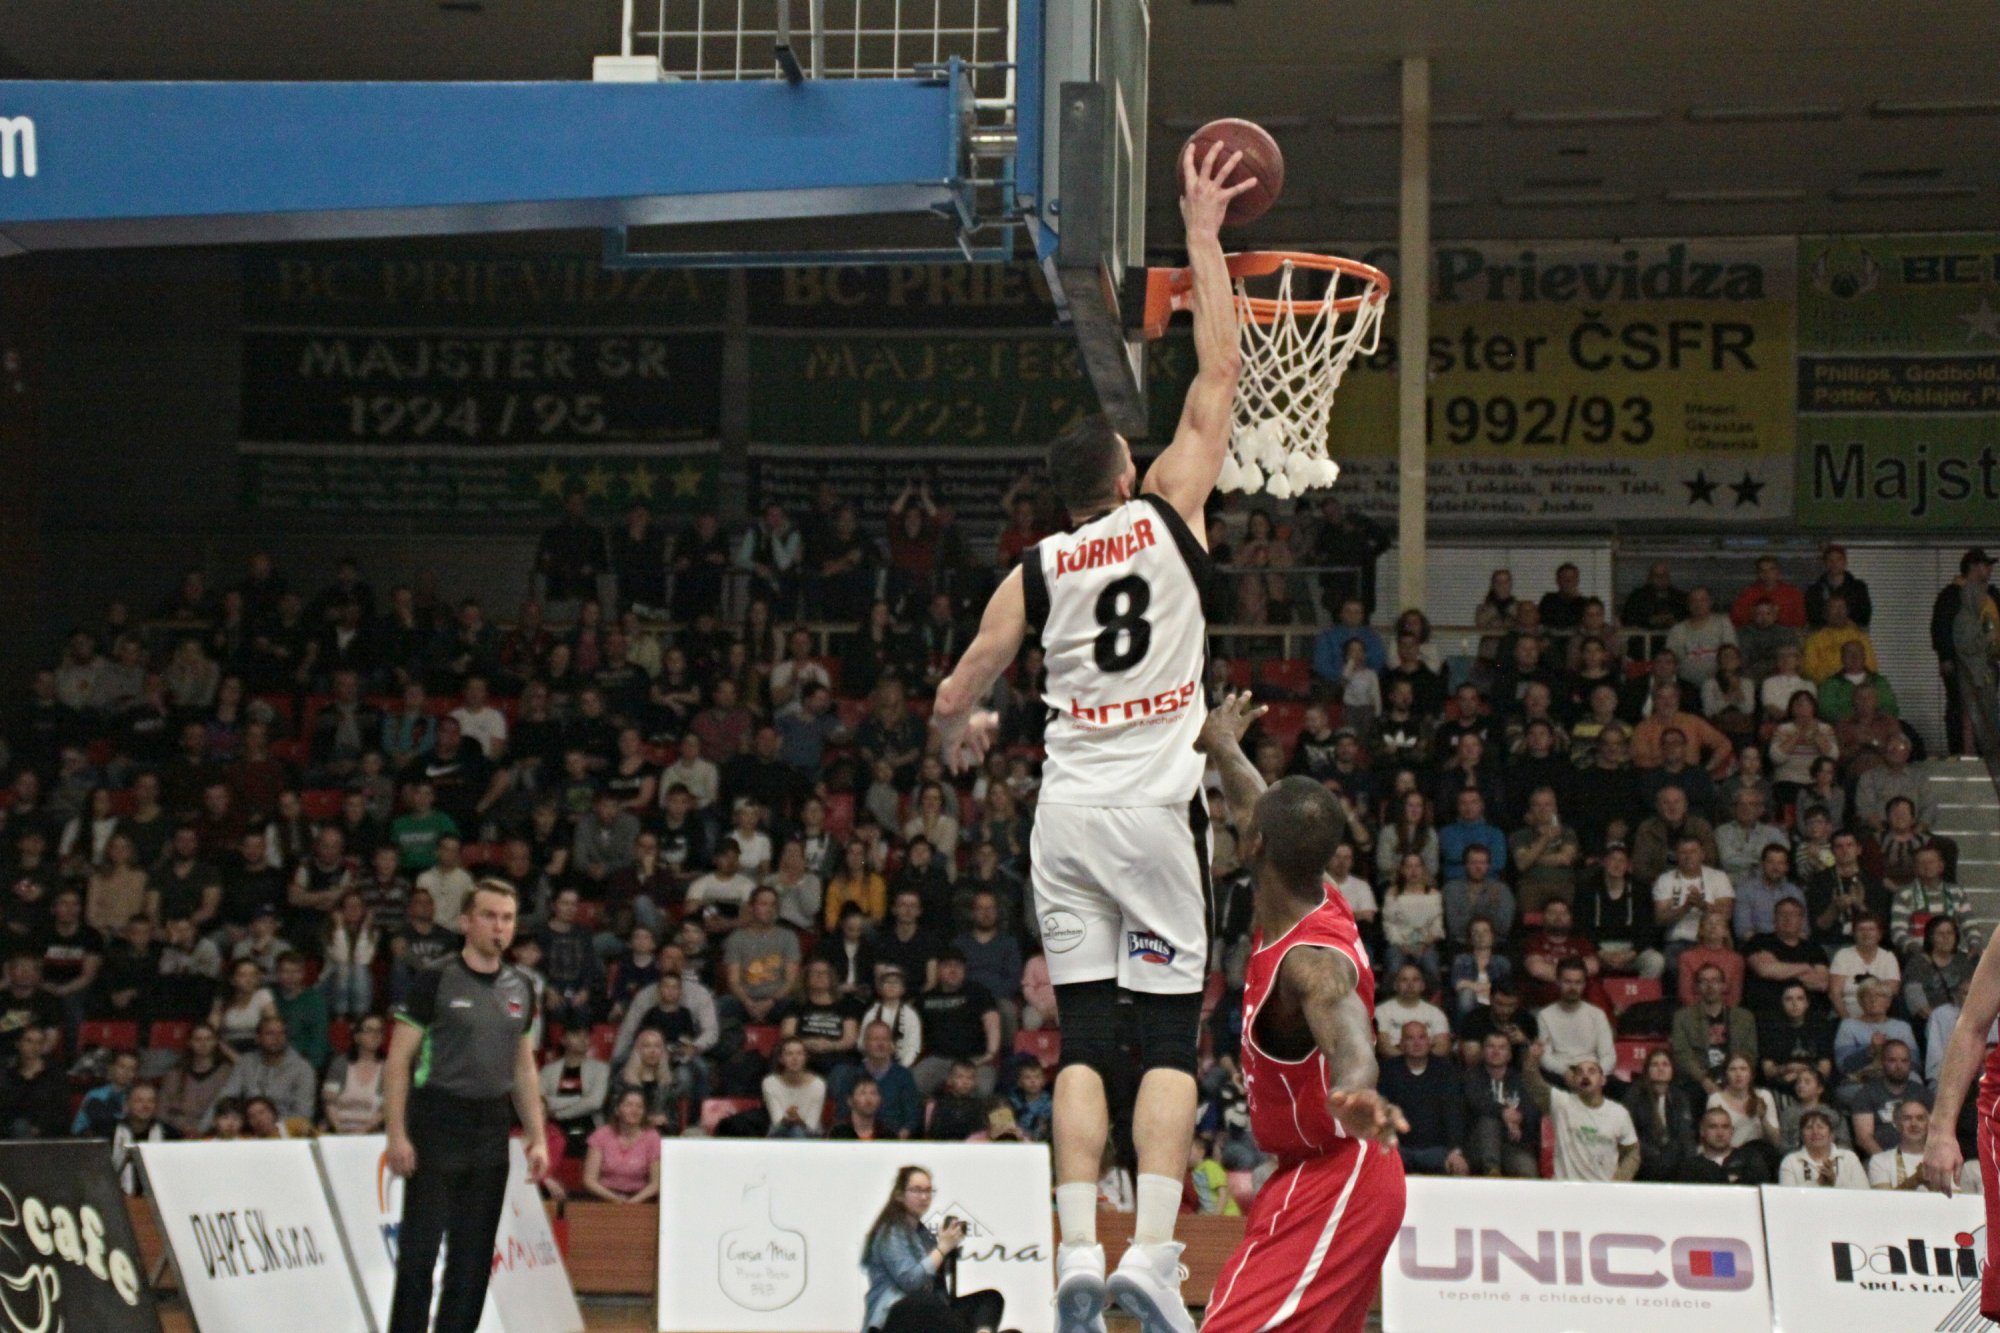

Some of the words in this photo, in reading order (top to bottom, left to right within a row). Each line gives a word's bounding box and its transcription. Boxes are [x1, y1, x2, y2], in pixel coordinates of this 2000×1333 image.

[1435, 240, 1766, 302] Prievidza
[298, 340, 577, 380] MAJSTER
[596, 339, 672, 380] SR
[1568, 309, 1760, 372] ČSFR
[343, 395, 482, 437] 1994
[533, 395, 608, 436] 95
[1424, 394, 1655, 446] 1992/93
[1092, 574, 1152, 674] 8
[726, 1239, 763, 1263] Casa
[765, 1240, 799, 1263] Mia
[928, 1222, 982, 1238] HEL
[1399, 1225, 1755, 1293] UNICO
[1831, 1231, 1984, 1283] patri
[1439, 1289, 1512, 1302] tepelné
[1520, 1292, 1531, 1302] a
[1538, 1290, 1627, 1307] chladové
[1635, 1295, 1713, 1310] izolácie
[1860, 1281, 1905, 1293] spol.
